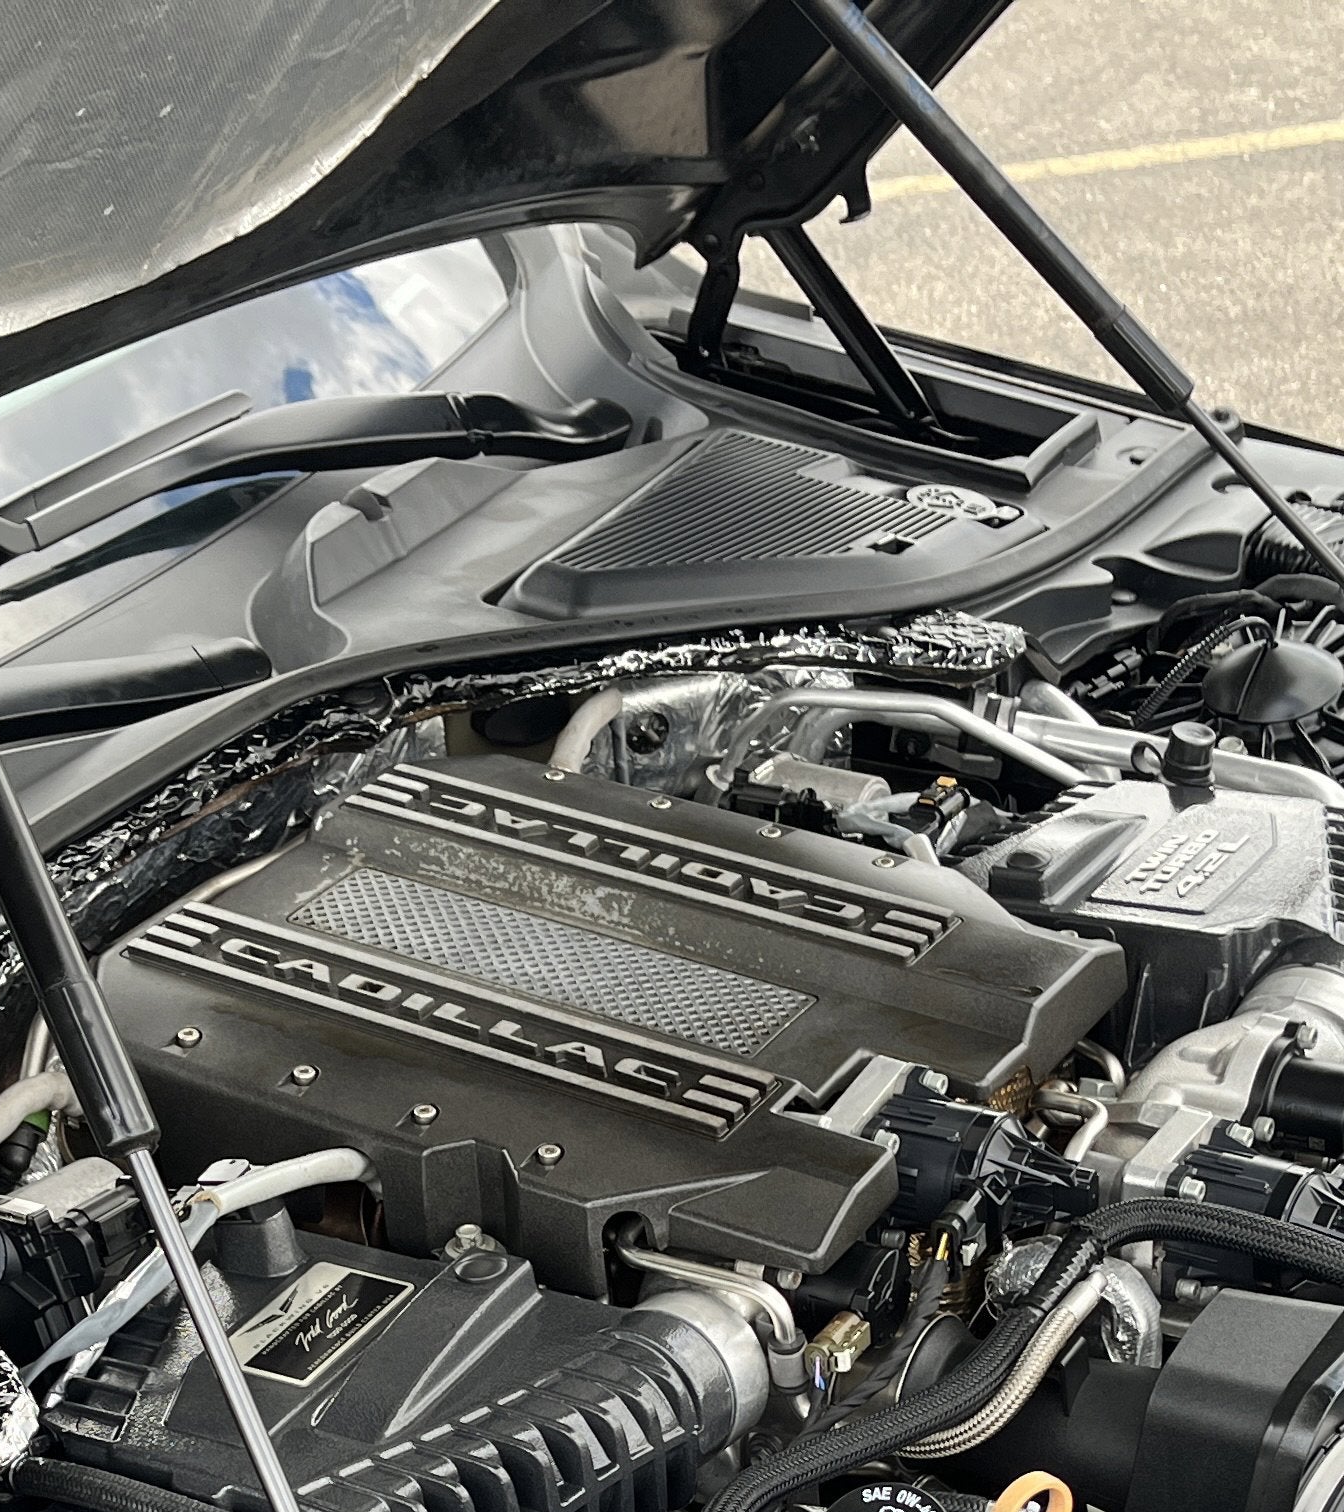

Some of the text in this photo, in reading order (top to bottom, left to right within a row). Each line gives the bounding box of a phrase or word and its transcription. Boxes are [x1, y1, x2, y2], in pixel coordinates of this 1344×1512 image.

[428, 793, 865, 929] CADILLAC
[1124, 832, 1189, 885] TWIN
[1139, 829, 1220, 894] TURBO
[1176, 834, 1250, 897] 4.2L
[219, 937, 683, 1096] CADILLAC
[861, 1486, 893, 1503] SAE
